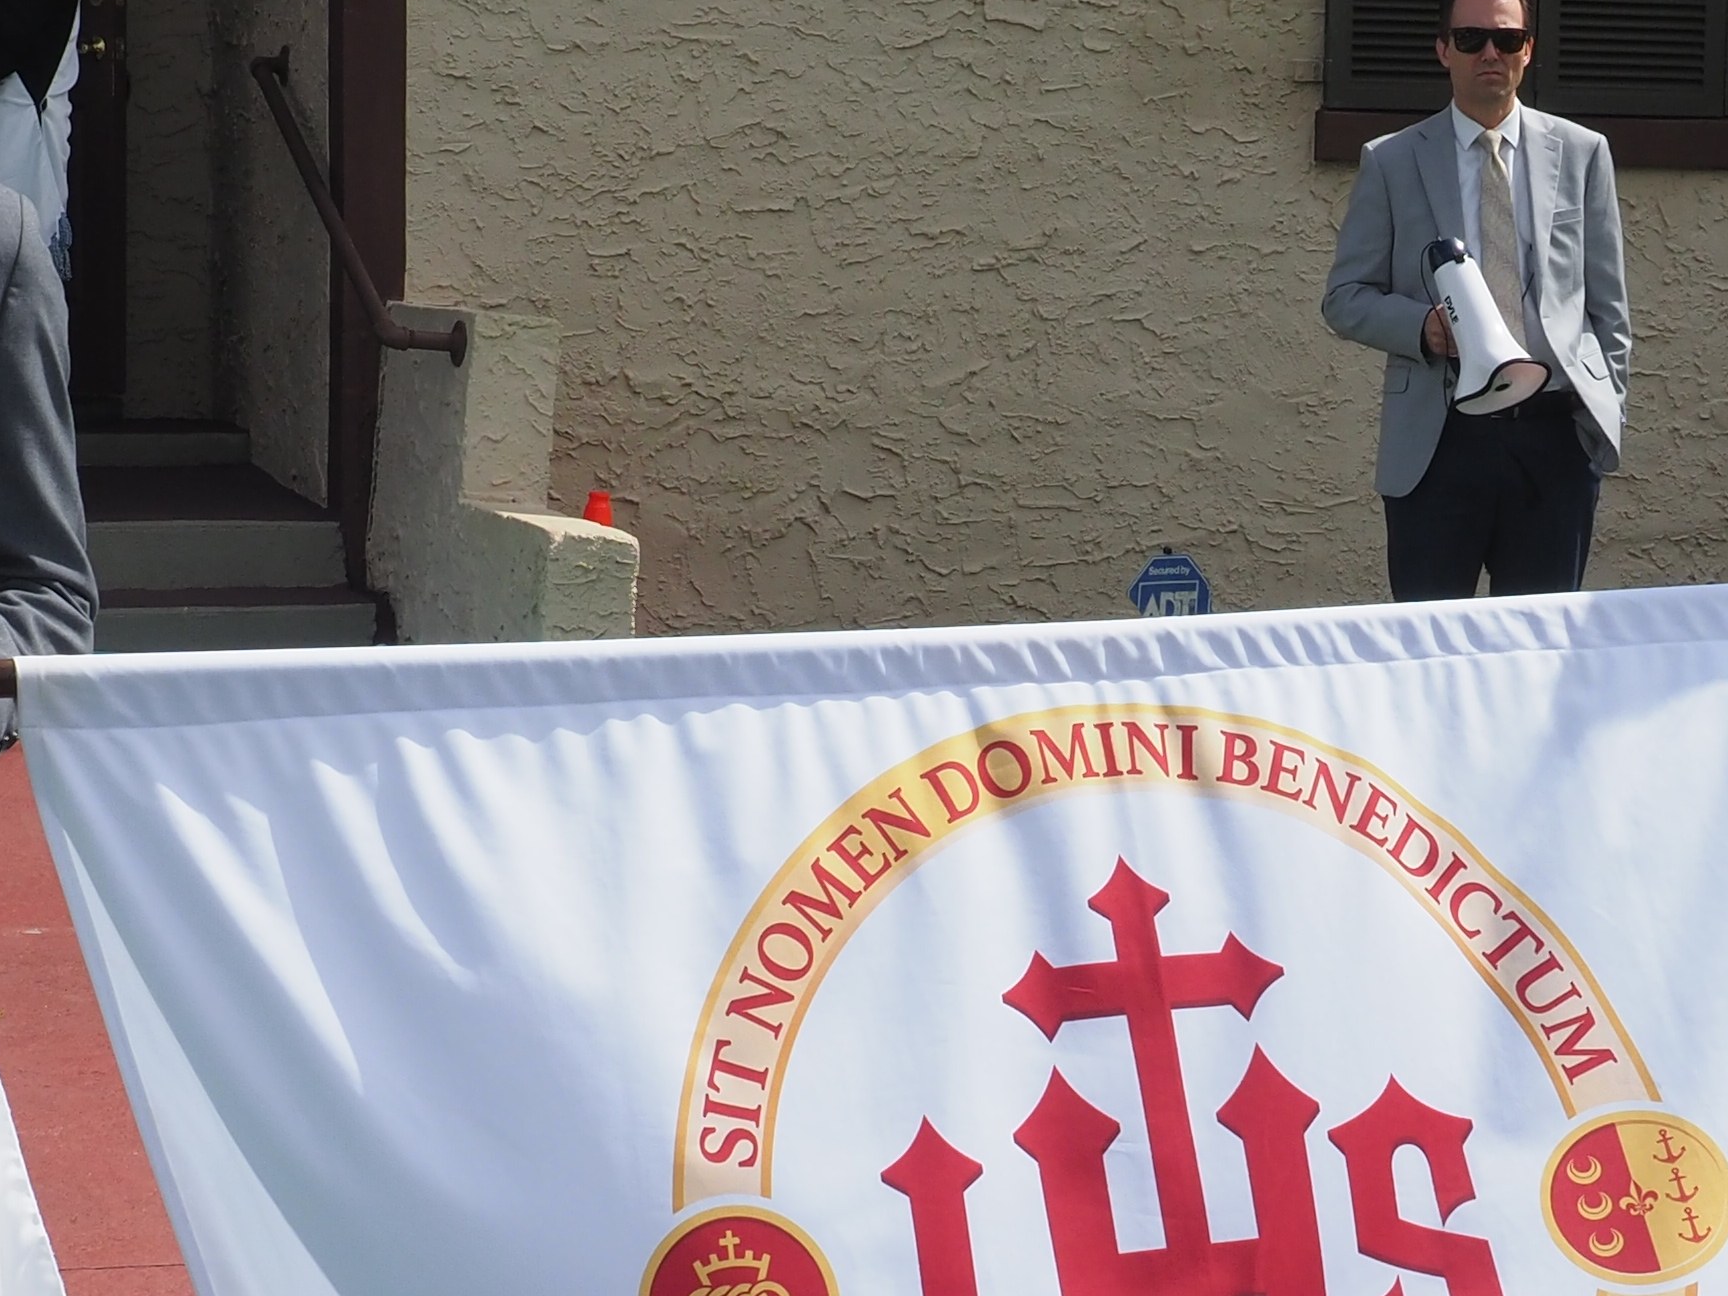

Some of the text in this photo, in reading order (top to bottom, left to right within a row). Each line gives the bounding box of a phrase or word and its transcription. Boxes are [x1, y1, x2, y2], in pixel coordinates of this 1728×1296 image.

[1148, 565, 1191, 577] Secured by
[1142, 590, 1198, 617] ADT
[698, 720, 1619, 1169] SIT NOMEN DOMINI BENEDICTUM
